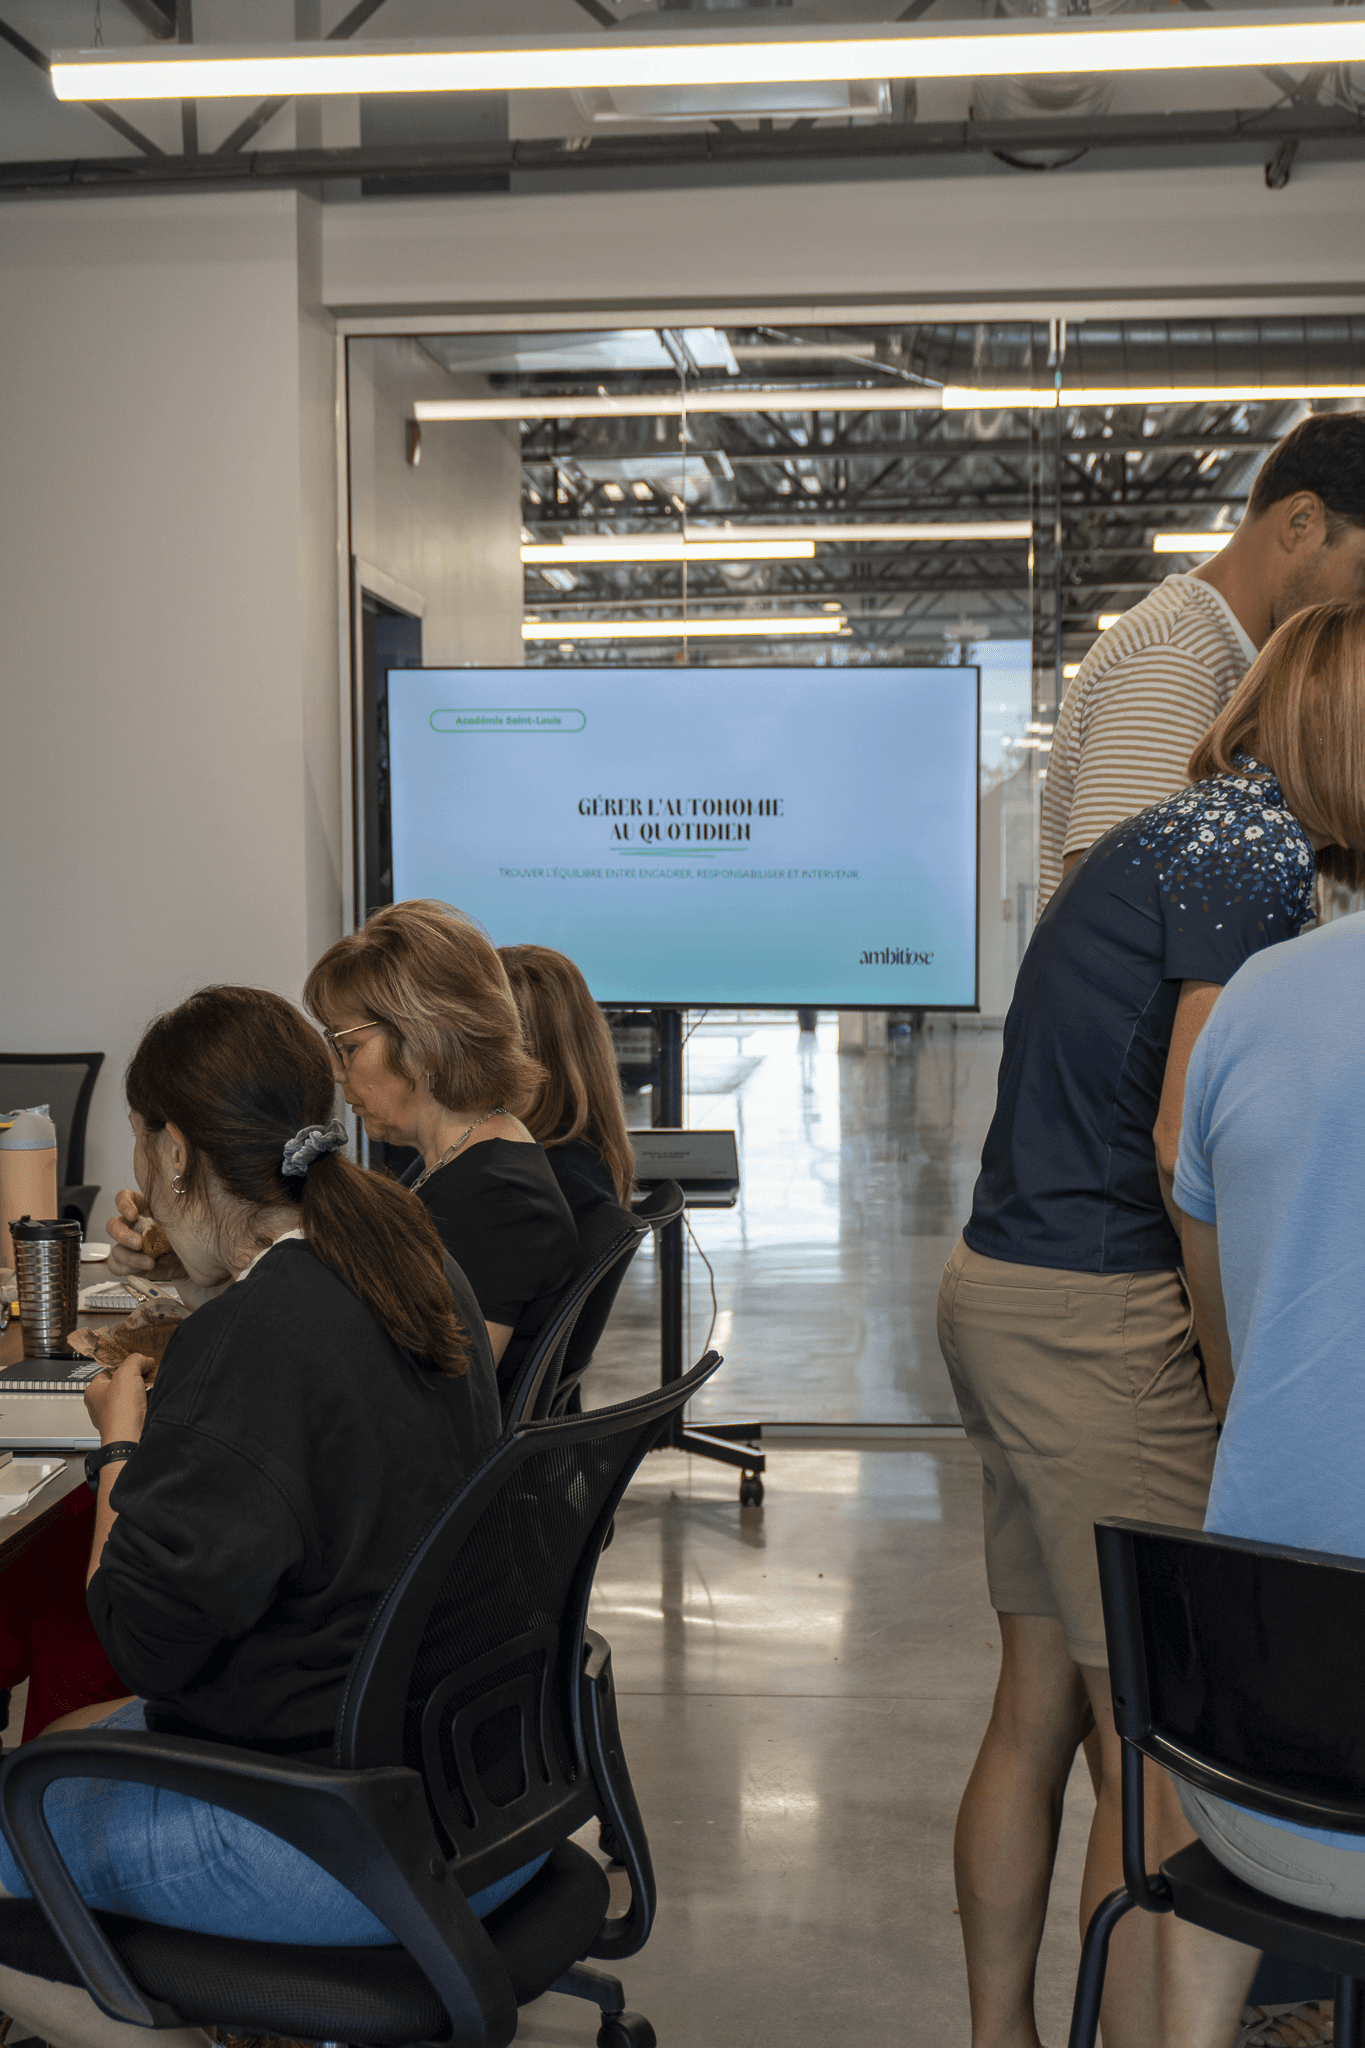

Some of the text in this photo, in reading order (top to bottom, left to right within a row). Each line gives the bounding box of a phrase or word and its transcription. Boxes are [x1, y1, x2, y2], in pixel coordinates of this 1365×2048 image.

[455, 715, 562, 725] Académie Saint-Louis
[578, 793, 784, 817] GÉRER L'AUTONOMIE
[609, 822, 750, 844] AU QUOTIDIEN
[499, 868, 544, 878] TROUVER
[546, 866, 602, 880] L'ÉQUILIBRE
[605, 868, 637, 878] ENTRE
[697, 869, 785, 879] RESPONSABILISER
[787, 869, 799, 879] ET
